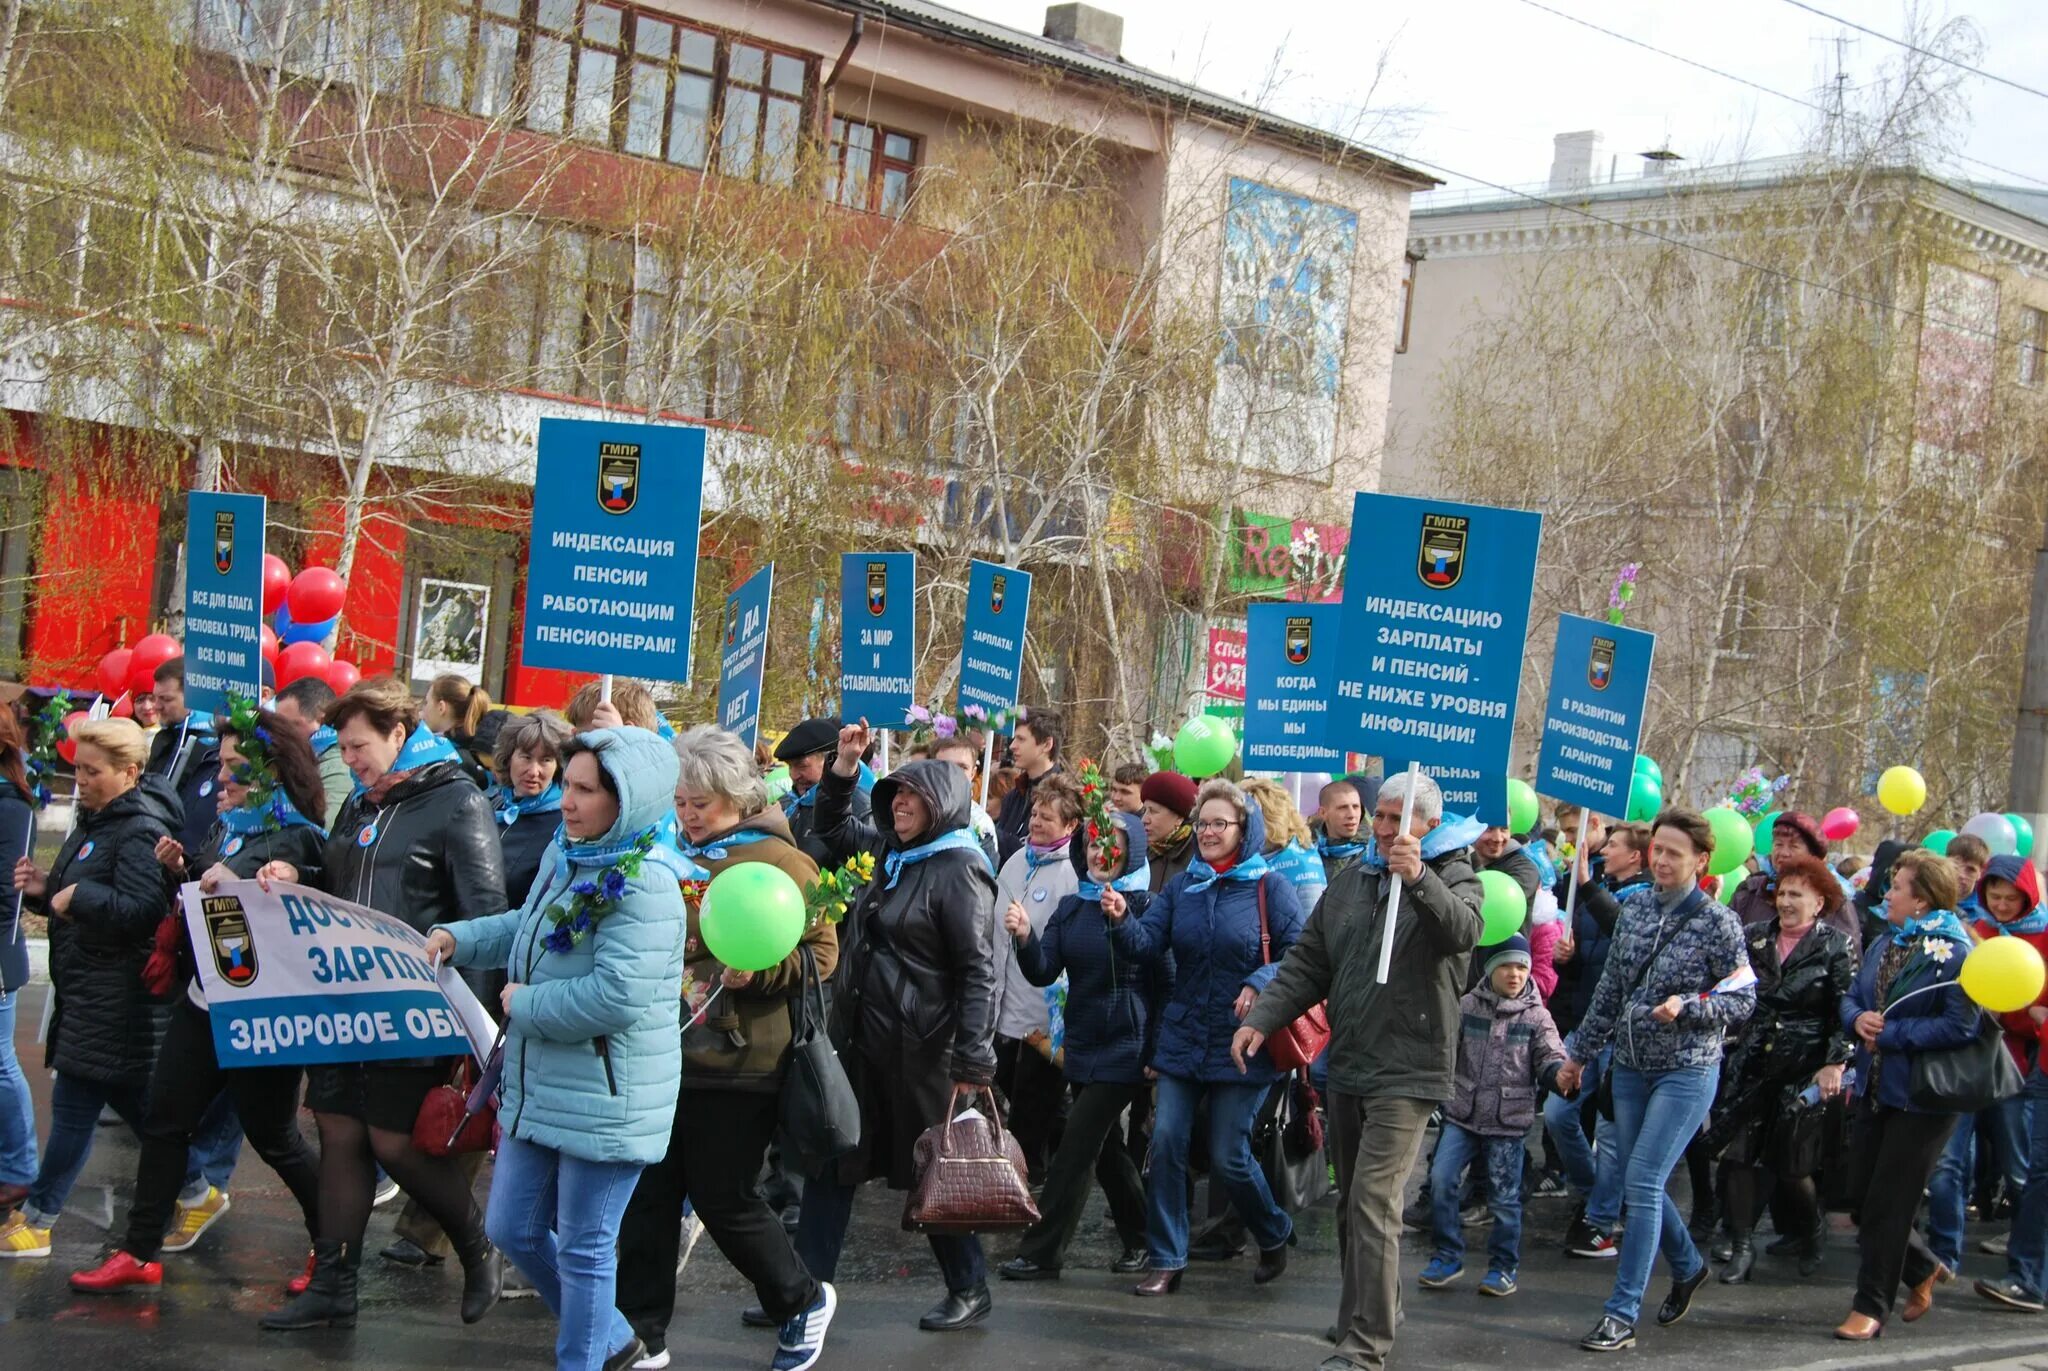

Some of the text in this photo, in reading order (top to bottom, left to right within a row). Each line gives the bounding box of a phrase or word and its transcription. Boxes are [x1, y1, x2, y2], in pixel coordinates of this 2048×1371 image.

[602, 443, 639, 456] ГМПР
[1425, 514, 1467, 530] ГМПР
[552, 531, 675, 558] ИНДЕКСАЦИЯ
[573, 565, 648, 587] ПЕНСИИ
[868, 563, 886, 573] ГМПР
[192, 590, 254, 611] ВСЕ ДЛЯ БЛАГА
[543, 594, 674, 622] РАБОТАЮЩИМ
[742, 605, 760, 642] ДА
[1287, 617, 1311, 626] ГМПР
[1365, 596, 1503, 630] ИНДЕКСАЦИЮ
[187, 617, 259, 644] ЧЕЛОВЕКА ТРУДА,
[536, 625, 677, 654] ПЕНСИОНЕРАМ!
[861, 629, 893, 646] ЗА МИР
[972, 629, 1014, 652] ЗАРПЛАТА!
[1376, 627, 1483, 657] ЗАРПЛАТЫ
[1594, 637, 1615, 649] ГМПР
[197, 646, 246, 667] ВСЕ ВО ИМЯ
[722, 648, 740, 671] РОСТУ
[873, 653, 880, 669] И
[967, 656, 1013, 681] ЗАНЯТОСТЬ!
[1371, 656, 1386, 673] И
[1389, 657, 1469, 684] ПЕНСИЙ
[842, 674, 912, 695] СТАБИЛЬНОСТЬ!
[1276, 676, 1317, 691] КОГДА
[726, 690, 750, 726] НЕТ
[1257, 699, 1327, 713] МЫ ЕДИНЫ
[1337, 679, 1508, 719] НЕ НИЖЕ УРОВНЯ
[1561, 697, 1626, 727] В РАЗВИТИИ
[1283, 721, 1306, 735] МЫ
[1360, 712, 1477, 745] ИНФЛЯЦИИ!
[1548, 717, 1633, 752] ПРОИЗВОДСТВА-
[1560, 745, 1613, 771] ГАРАНТИЯ
[1419, 764, 1481, 779] ИЛЬНАЯ
[1551, 766, 1615, 796] ЗАНЯТОСТИ!
[205, 897, 240, 914] ГМПР
[308, 945, 437, 984] ЗАРПЛА
[229, 1012, 400, 1056] ЗДОРОВОЕ
